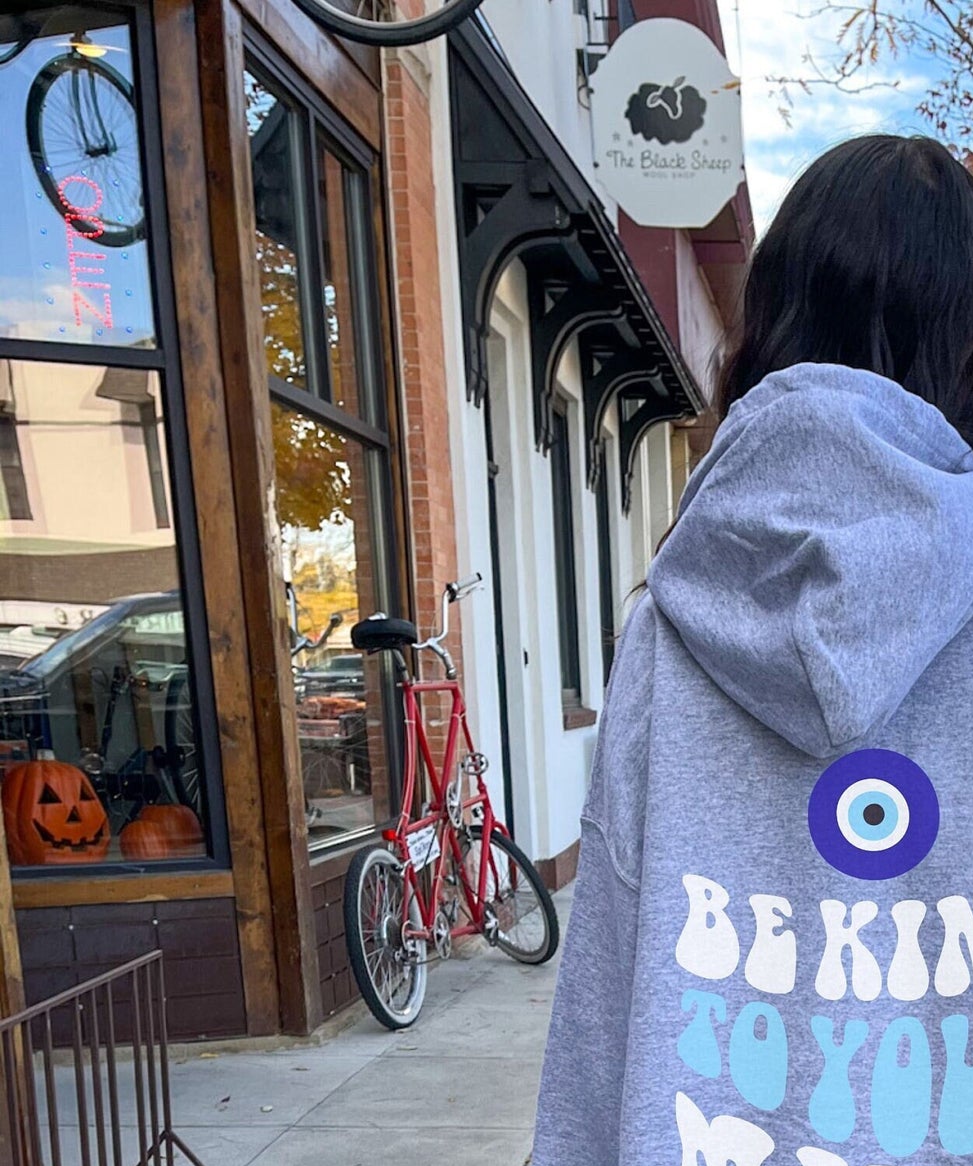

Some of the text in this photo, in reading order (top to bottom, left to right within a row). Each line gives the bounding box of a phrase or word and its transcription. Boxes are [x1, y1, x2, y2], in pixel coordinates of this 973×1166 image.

[606, 150, 732, 174] The Black Sheep
[58, 176, 114, 328] OPEN
[675, 874, 797, 994] BE
[677, 988, 788, 1112] TO
